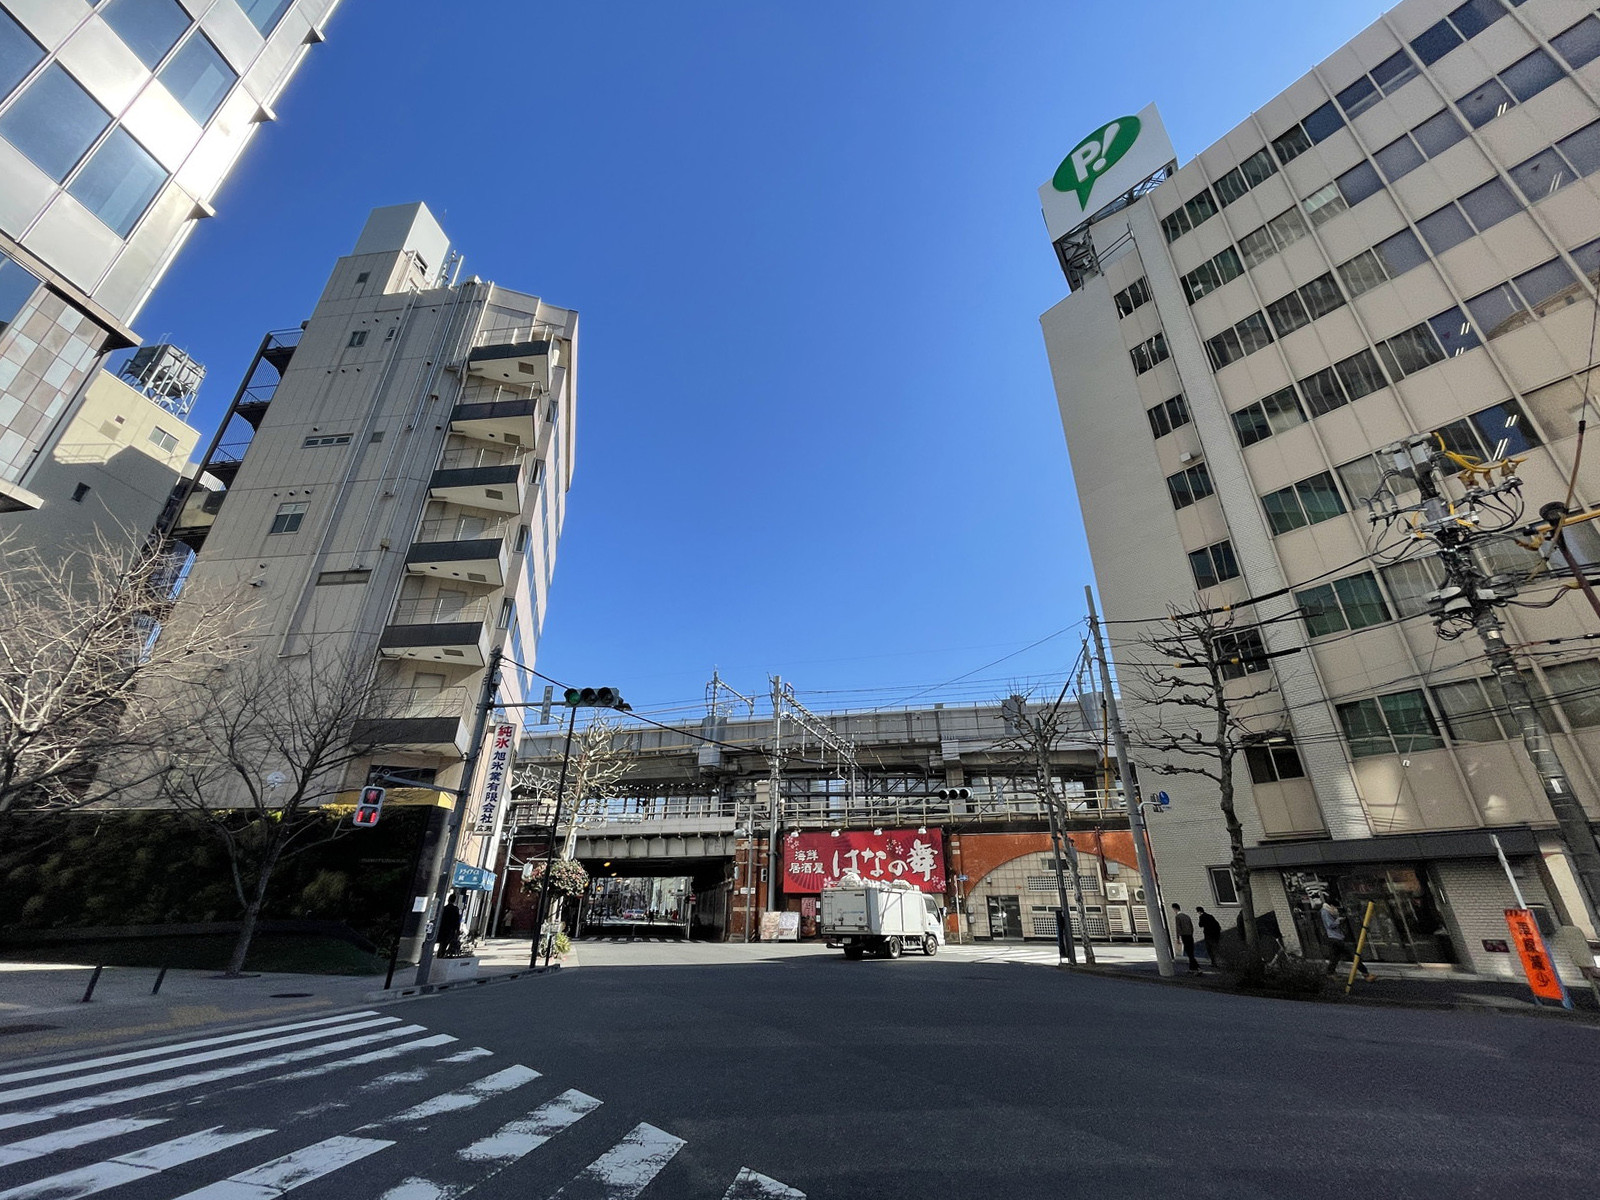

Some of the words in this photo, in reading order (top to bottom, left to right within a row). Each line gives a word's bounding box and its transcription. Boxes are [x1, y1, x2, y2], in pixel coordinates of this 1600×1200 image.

[495, 725, 513, 749] 純氷
[479, 751, 507, 824] 旭氷業有限会社
[794, 849, 819, 861] 海鮮
[832, 838, 939, 882] はなの舞
[788, 862, 826, 874] 居酒屋
